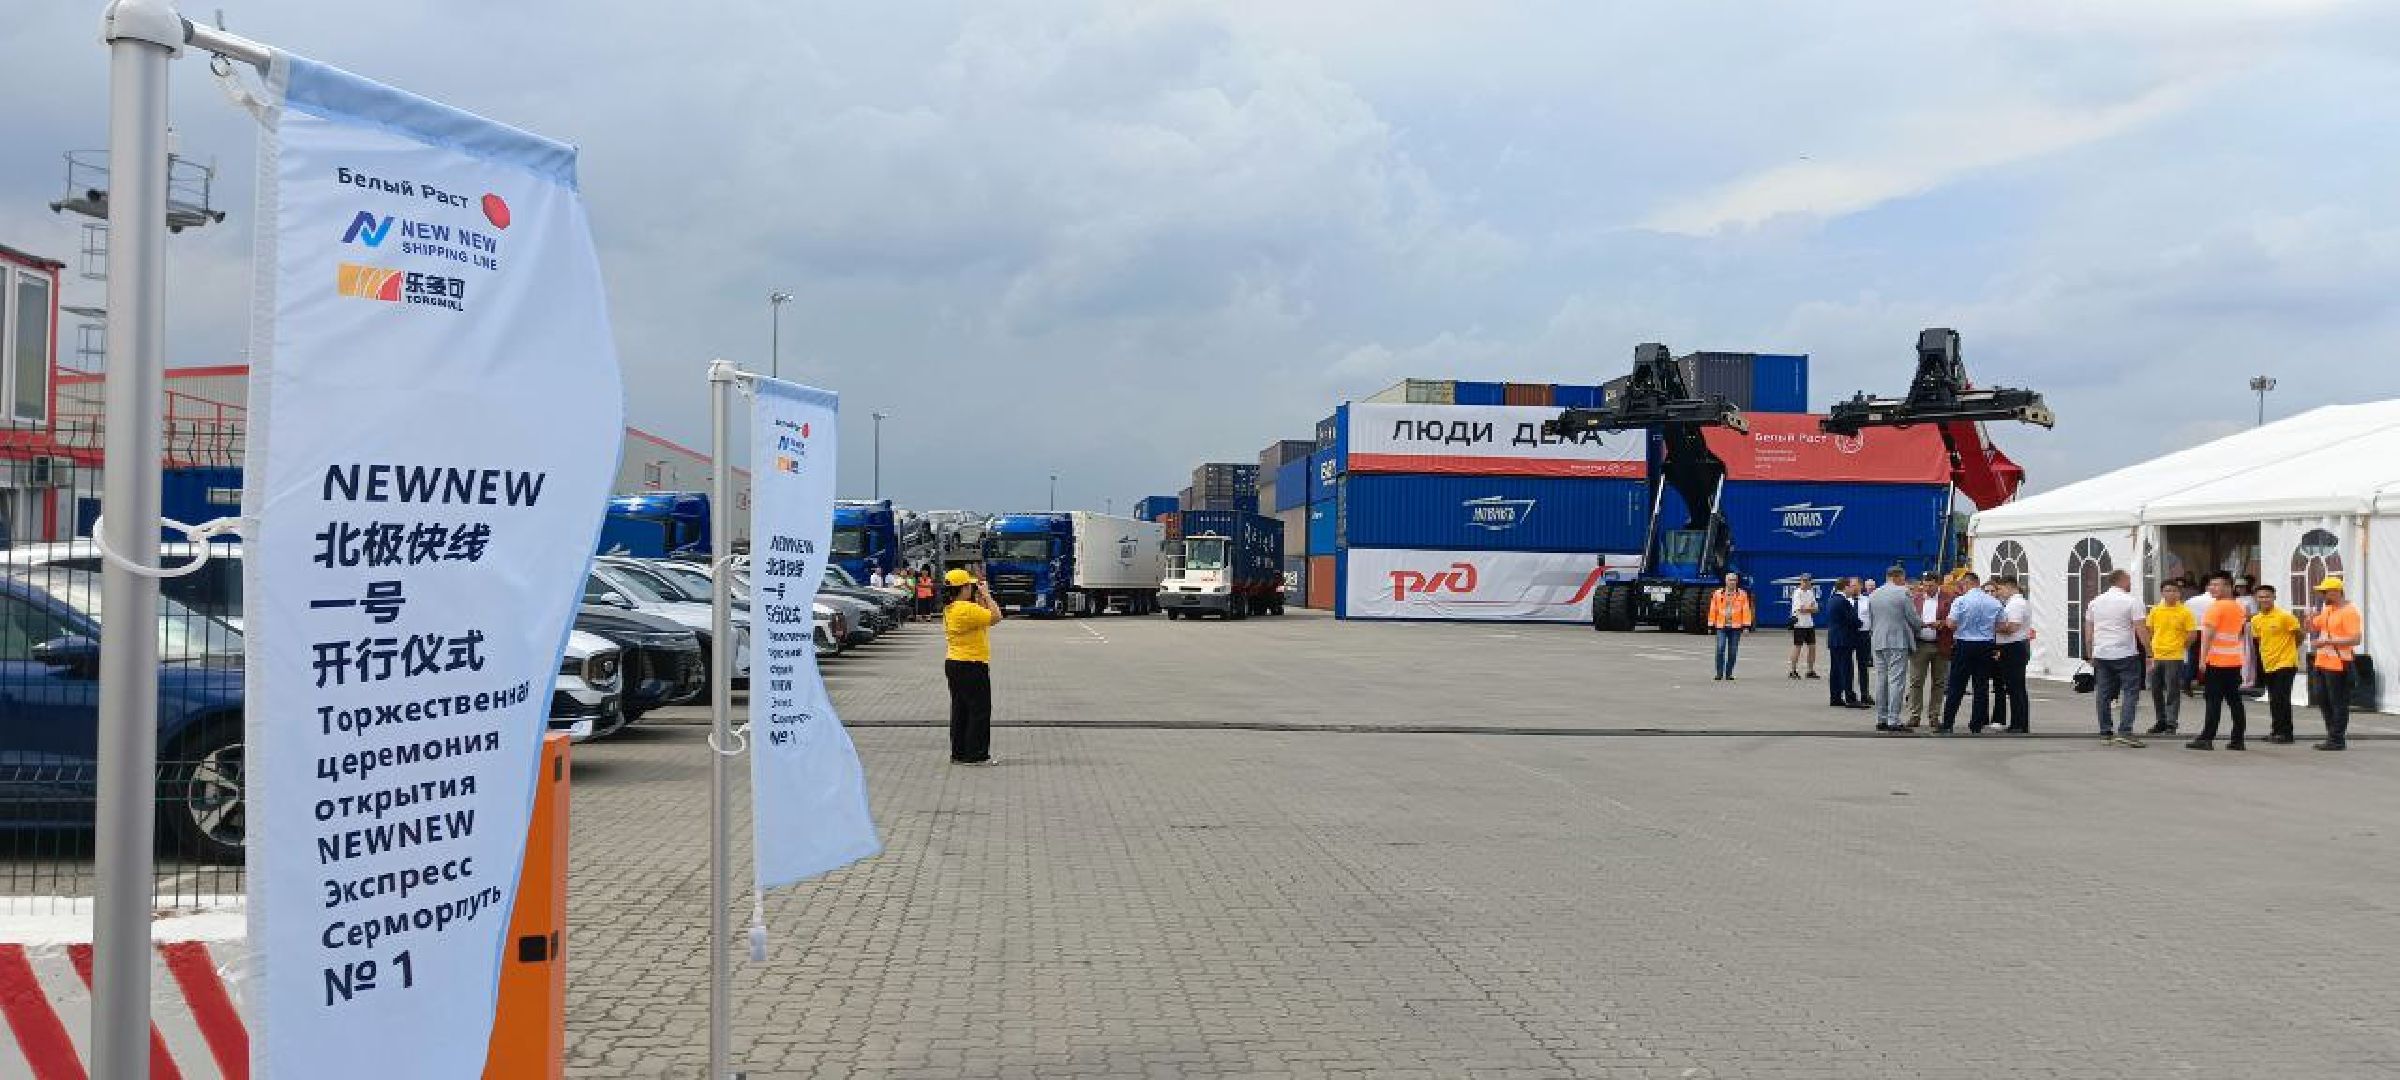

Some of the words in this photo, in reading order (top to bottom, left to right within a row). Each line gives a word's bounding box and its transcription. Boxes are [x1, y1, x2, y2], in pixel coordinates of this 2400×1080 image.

[338, 168, 415, 197] Белый
[421, 184, 468, 208] Раст
[402, 218, 450, 242] NEW
[458, 229, 497, 254] NEW
[402, 241, 468, 263] SHIPPING
[1392, 420, 1493, 447] ЛЮДИ
[322, 464, 546, 507] NEWNEW
[313, 520, 491, 569] 北极快线
[310, 580, 406, 625] 一号
[312, 629, 484, 689] 开行仪式
[317, 731, 499, 783] церемония
[314, 775, 477, 821] открытия
[317, 809, 475, 864] NEWNEW
[324, 856, 473, 908] Экспресс
[321, 886, 500, 949] Серморпуть
[323, 960, 376, 1006] №
[392, 950, 412, 988] 1
